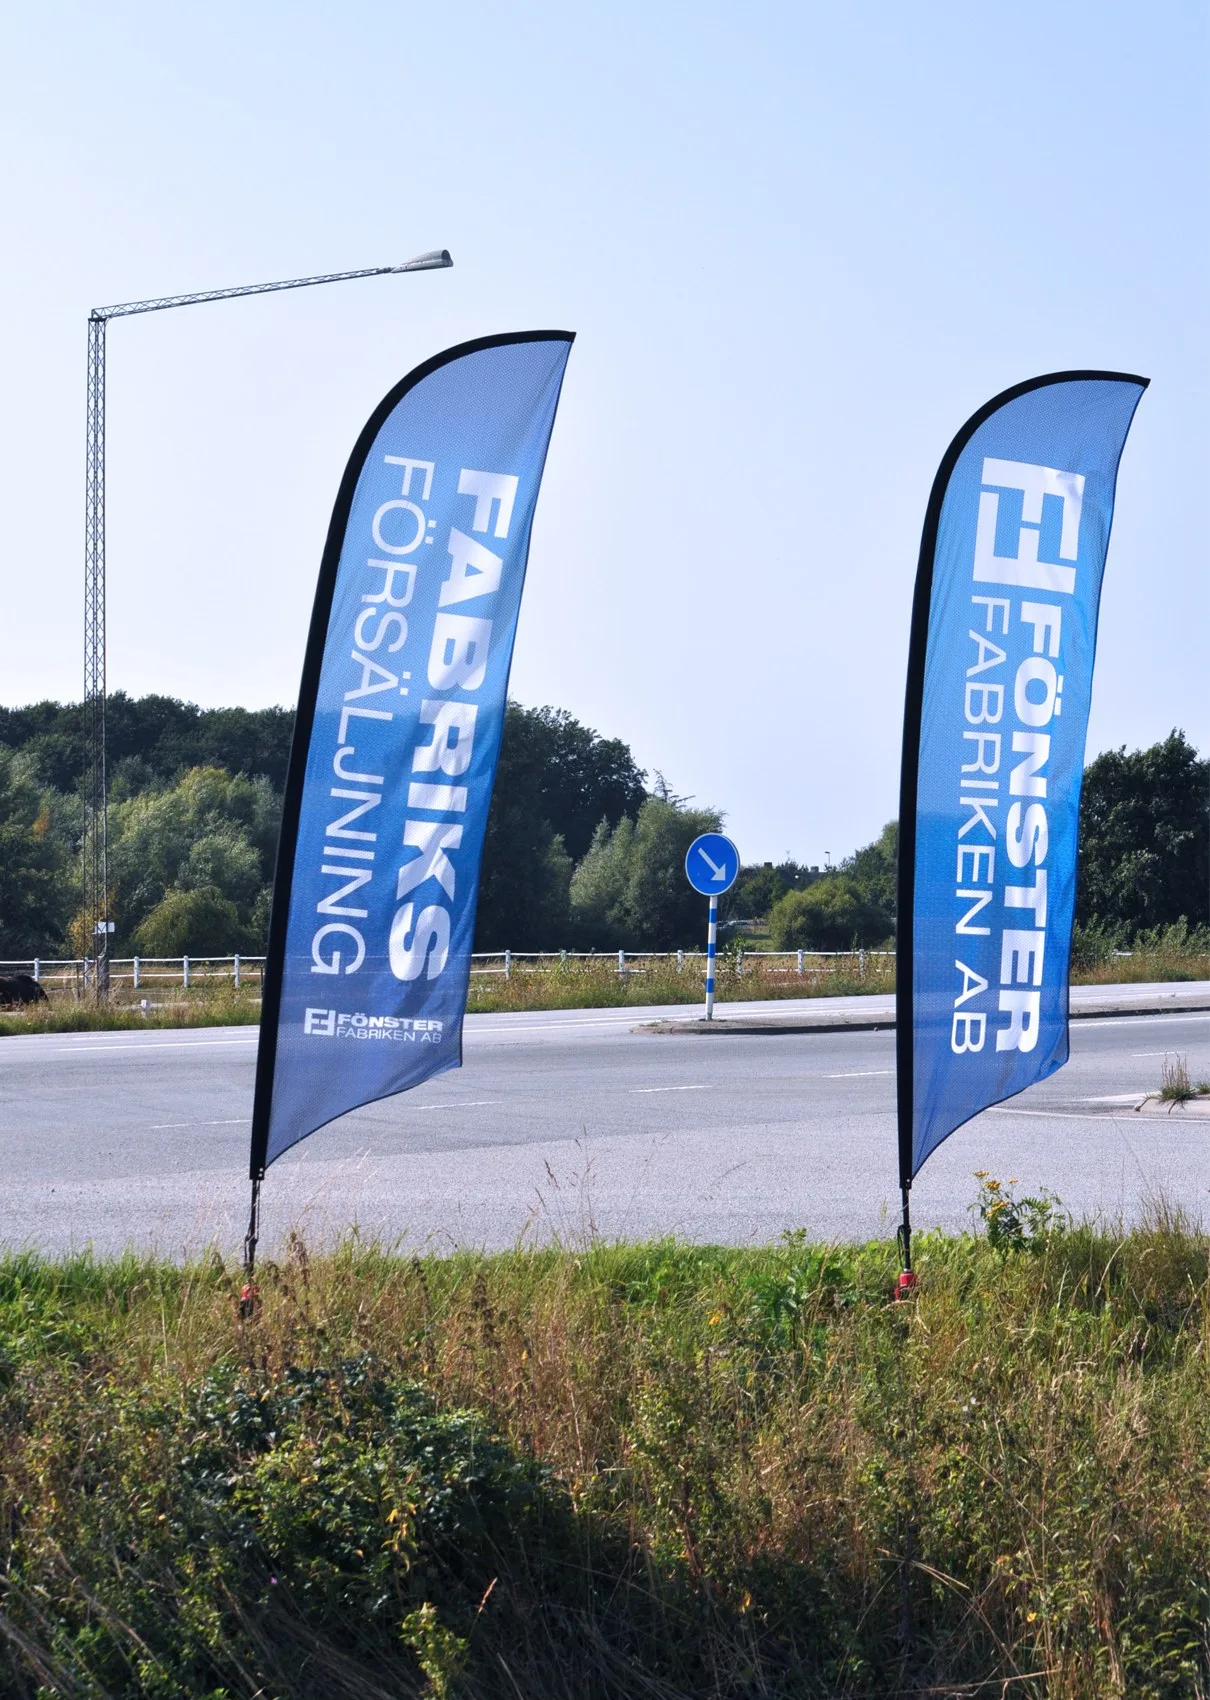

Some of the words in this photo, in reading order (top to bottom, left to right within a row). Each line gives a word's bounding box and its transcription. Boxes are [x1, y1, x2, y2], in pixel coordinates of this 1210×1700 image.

[310, 455, 436, 976] FÖRSÄLJNING
[388, 468, 519, 982] FABRIKS
[955, 595, 1011, 936] FABRIKEN
[995, 600, 1064, 1053] FÖNSTER
[336, 1026, 416, 1042] FABRIKEN
[420, 1031, 443, 1044] AB
[337, 1012, 444, 1032] FÖNSTER
[951, 959, 989, 1054] AB
